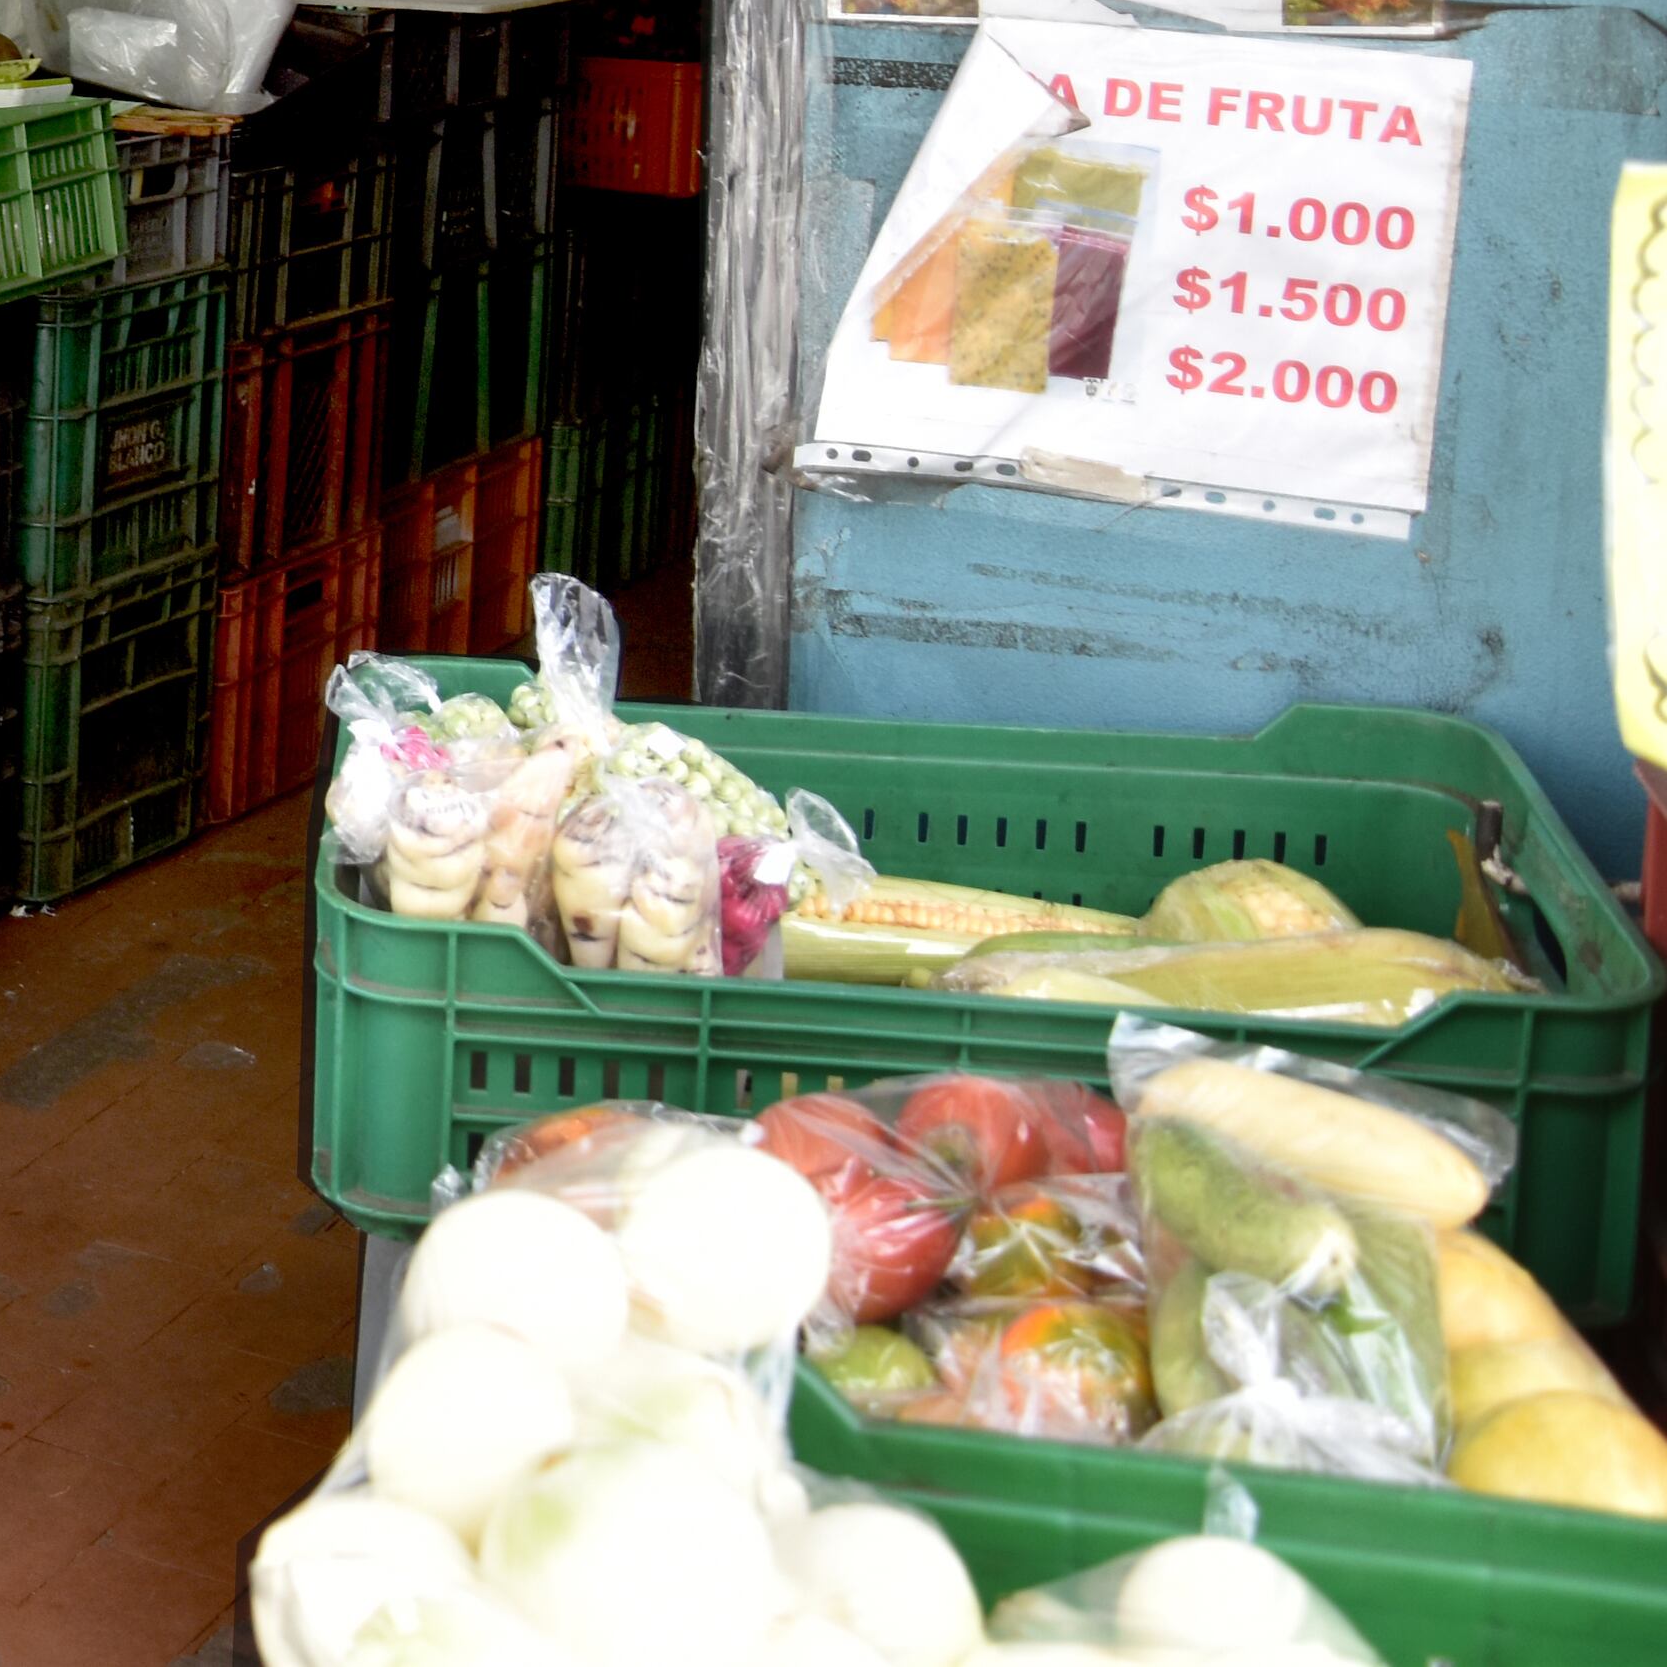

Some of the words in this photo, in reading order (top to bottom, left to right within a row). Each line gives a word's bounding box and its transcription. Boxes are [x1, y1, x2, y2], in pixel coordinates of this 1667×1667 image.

[1104, 77, 1185, 123] DE
[1206, 86, 1423, 147] FRUTA
[1180, 183, 1416, 251] $1.000
[1172, 265, 1407, 333] $1.500
[1166, 344, 1398, 415] $2.000
